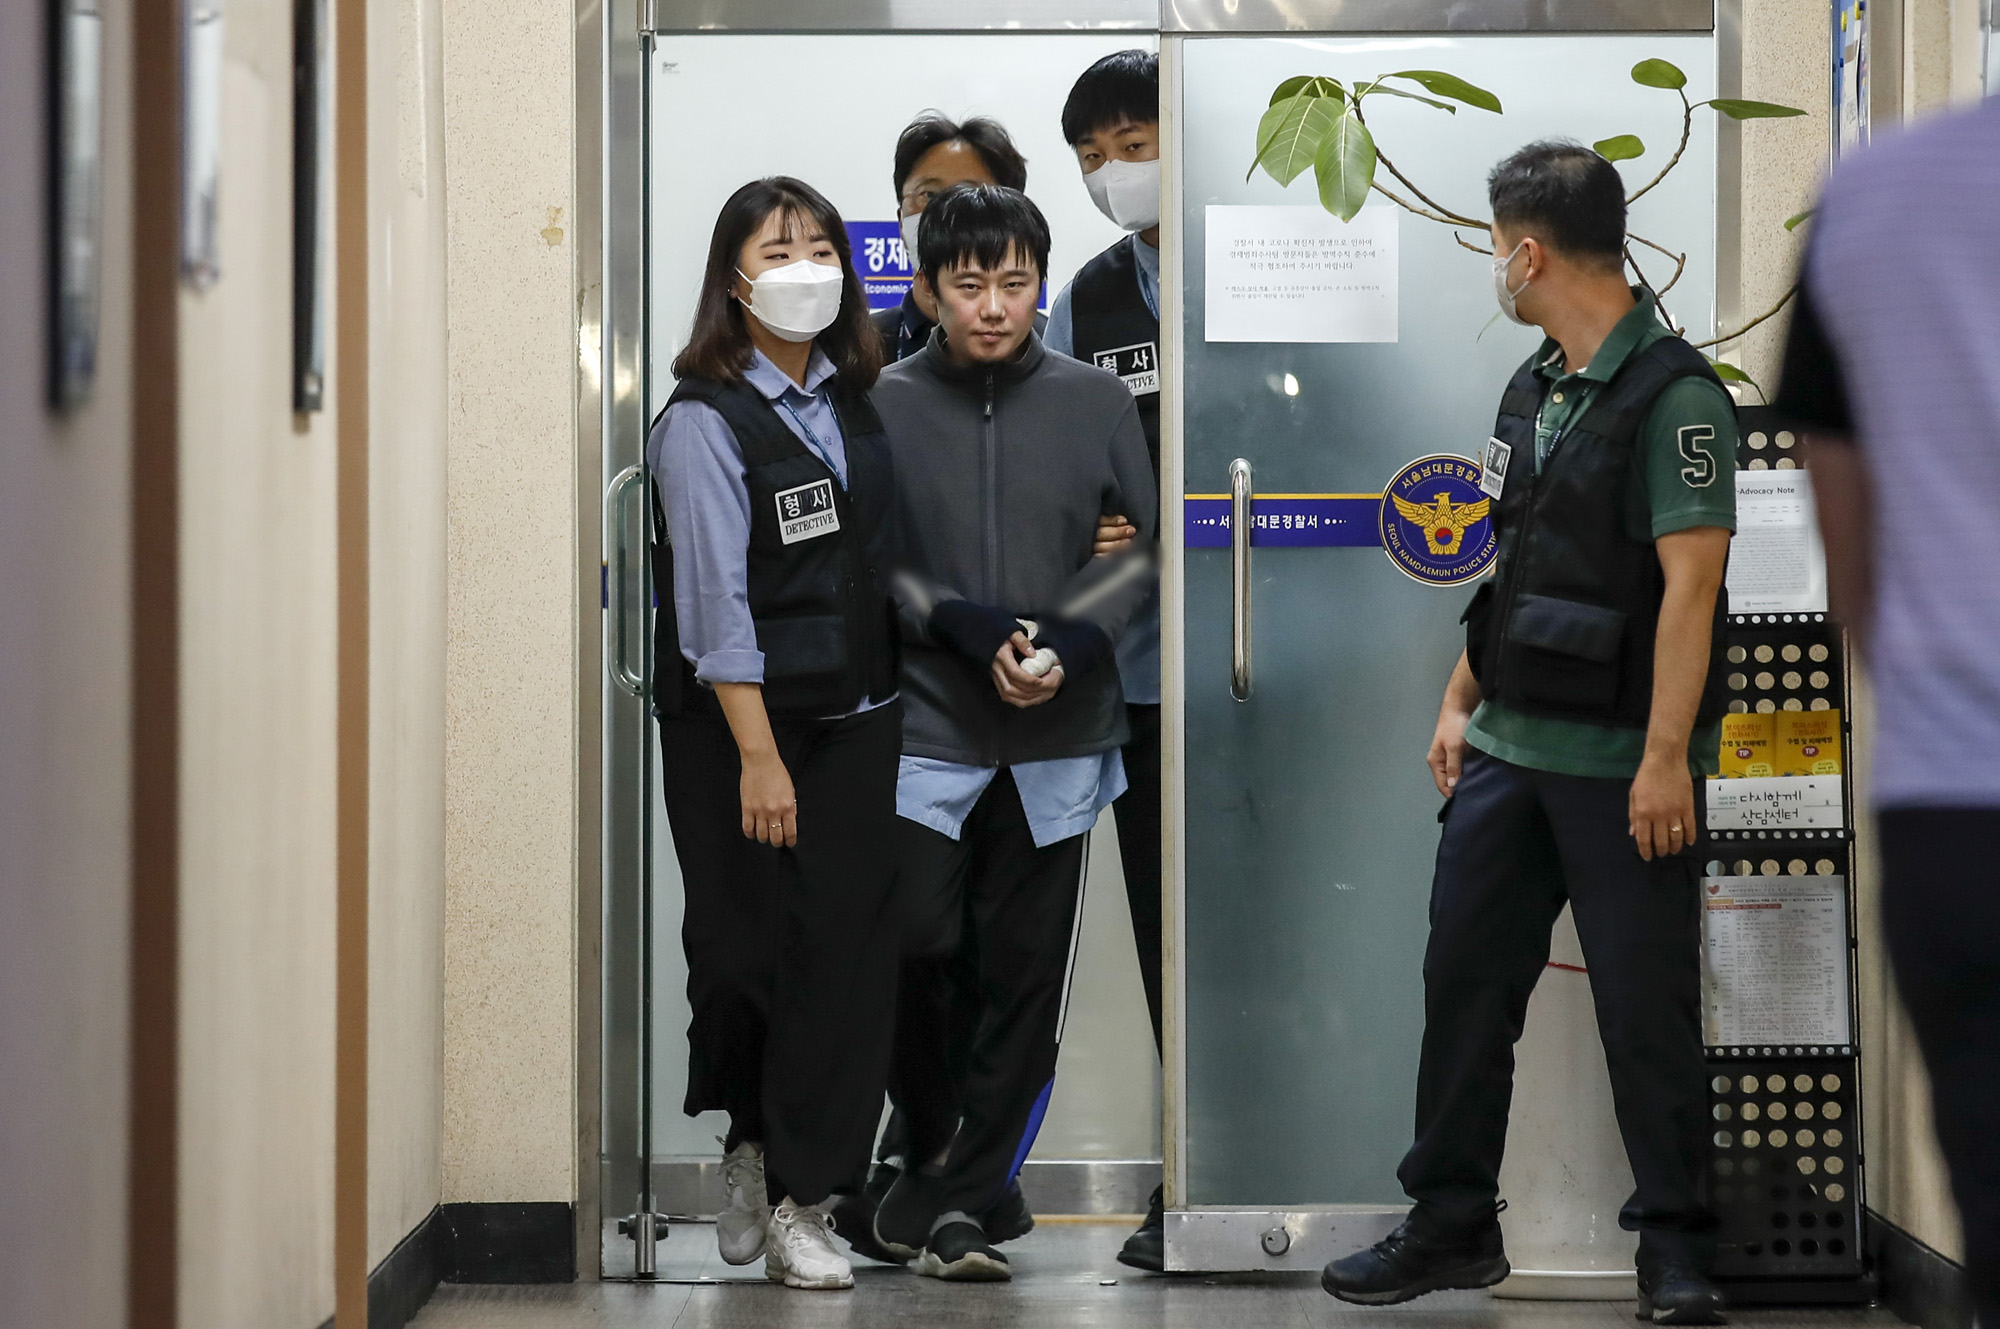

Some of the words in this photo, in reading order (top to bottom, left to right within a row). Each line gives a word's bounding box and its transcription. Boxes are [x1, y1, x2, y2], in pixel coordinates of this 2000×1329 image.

[1126, 375, 1155, 389] CTIVE
[1677, 424, 1716, 488] 5
[785, 513, 835, 536] DETECTIVE
[1219, 514, 1318, 529] 서대문경찰서
[1388, 523, 1401, 549] SEOUL
[1398, 550, 1451, 577] NAMDAEMUN
[1453, 556, 1483, 576] POLICE
[1740, 791, 1802, 807] 다시함께
[1741, 808, 1799, 826] 상담센터
